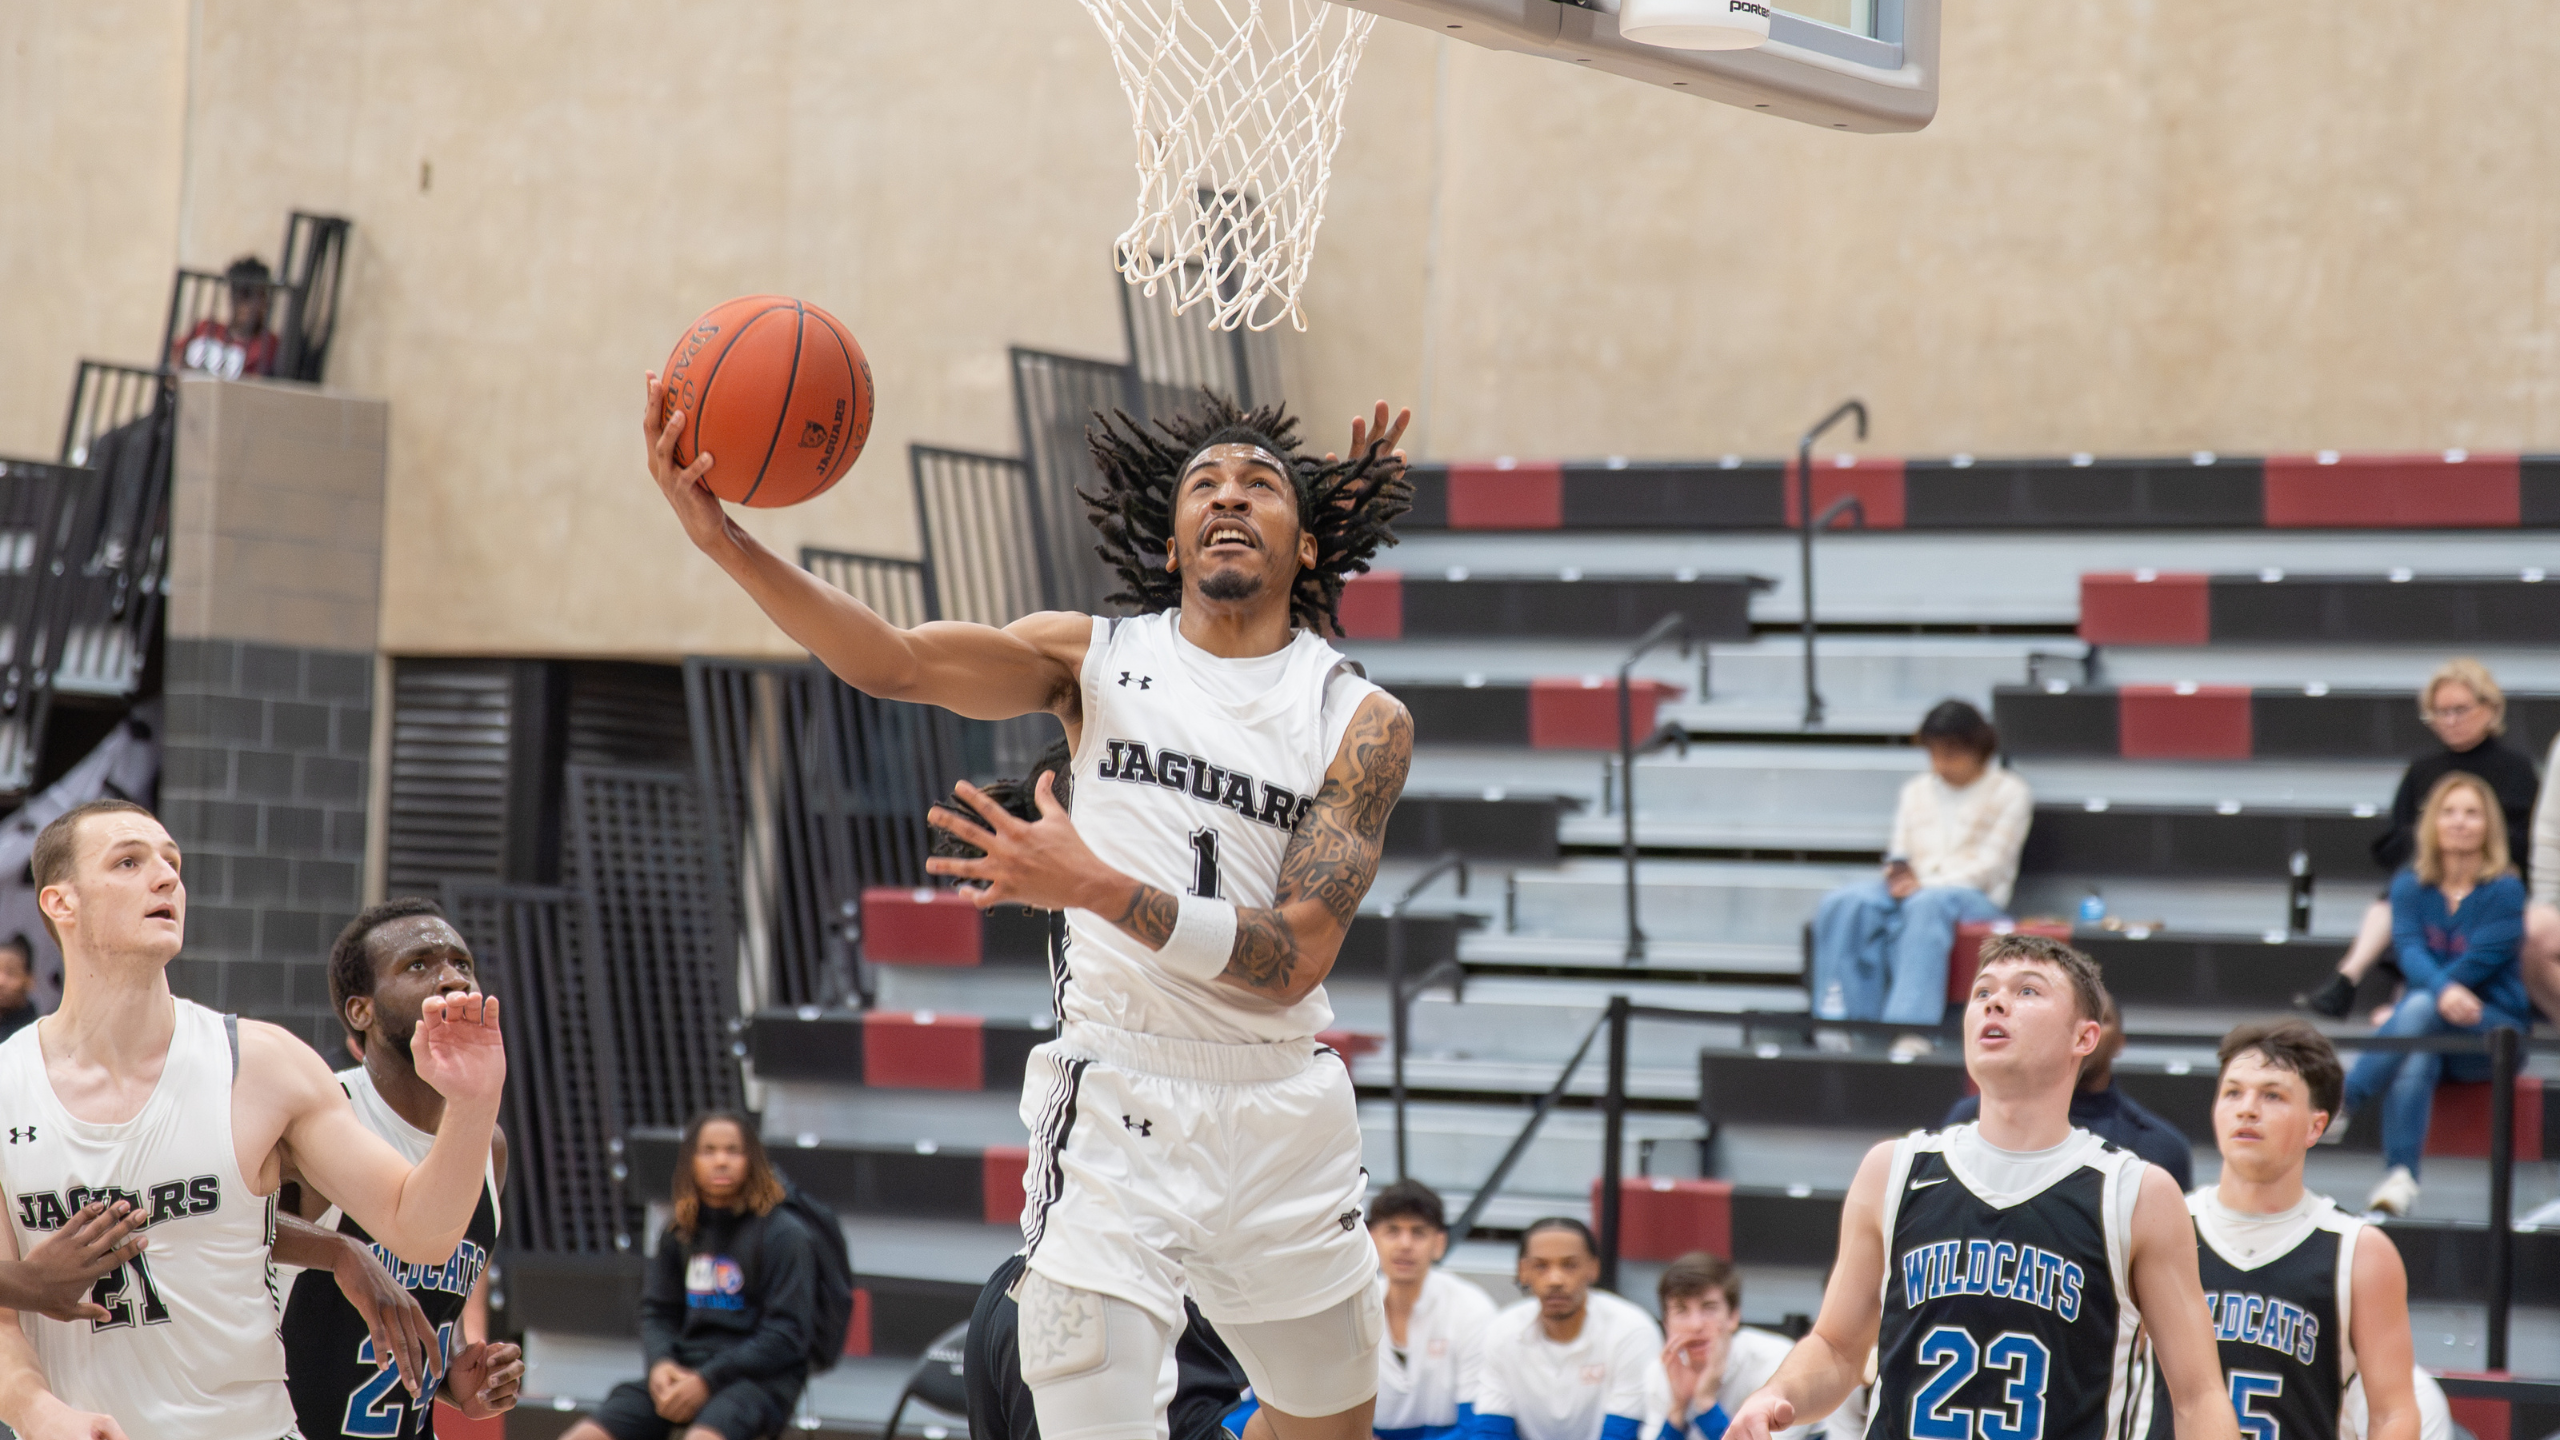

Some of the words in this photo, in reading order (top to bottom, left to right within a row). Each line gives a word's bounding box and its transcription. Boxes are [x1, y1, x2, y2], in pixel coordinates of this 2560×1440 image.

[816, 397, 846, 476] JAGUARS
[1187, 825, 1226, 901] 1
[1903, 1239, 2085, 1324] WILDCATS
[1909, 1325, 2051, 1440] 23
